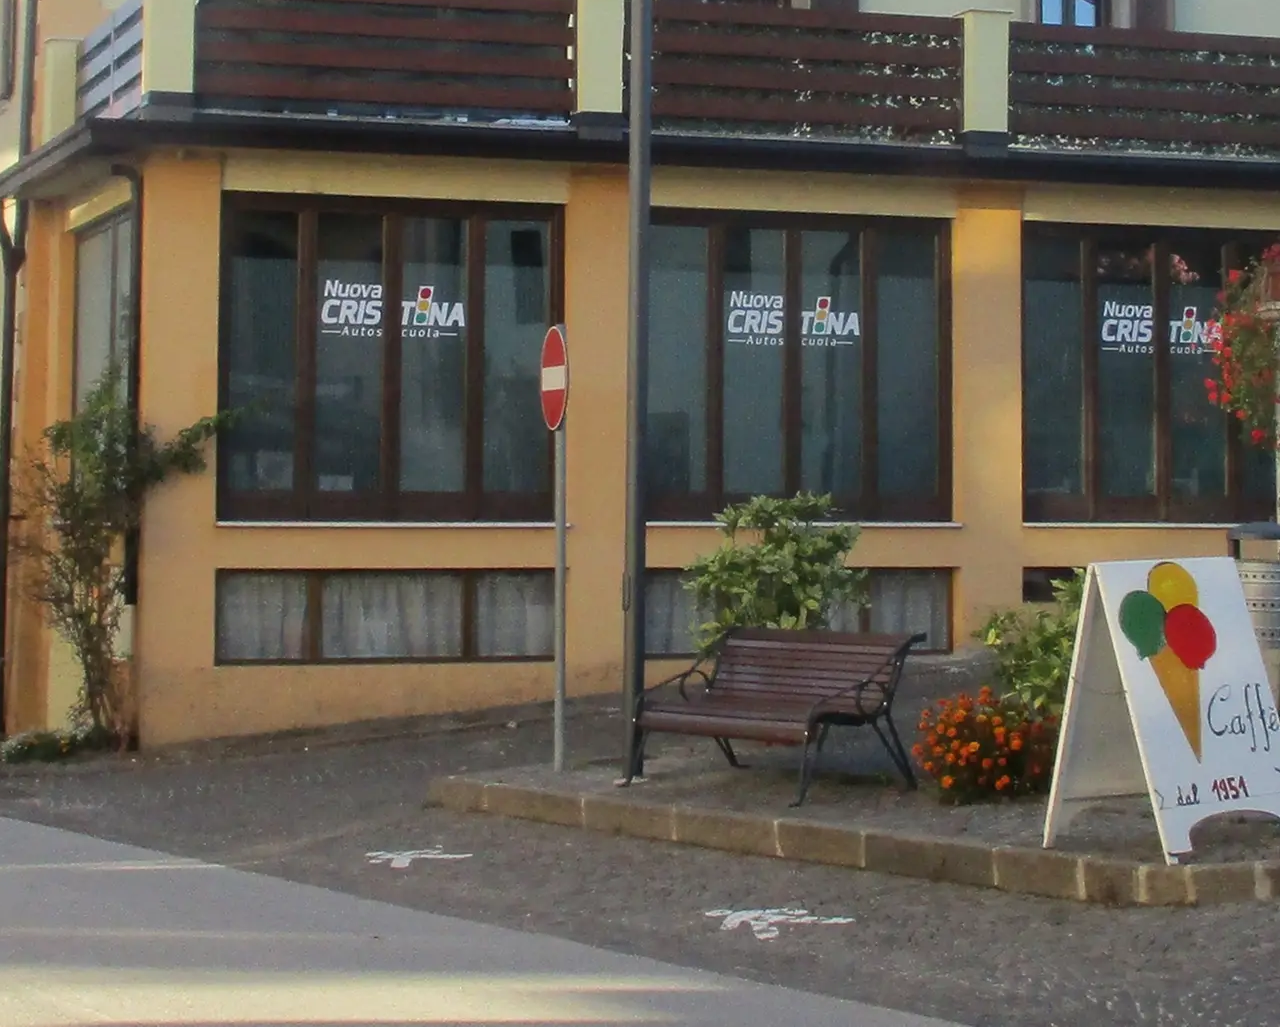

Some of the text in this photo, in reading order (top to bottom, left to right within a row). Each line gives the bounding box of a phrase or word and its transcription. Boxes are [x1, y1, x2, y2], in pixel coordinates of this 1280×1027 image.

[324, 280, 382, 299] Nuova
[730, 291, 784, 309] Nuova
[1104, 301, 1153, 318] Nuova
[1207, 683, 1280, 752] Caffè
[1176, 775, 1249, 807] dal 1951
